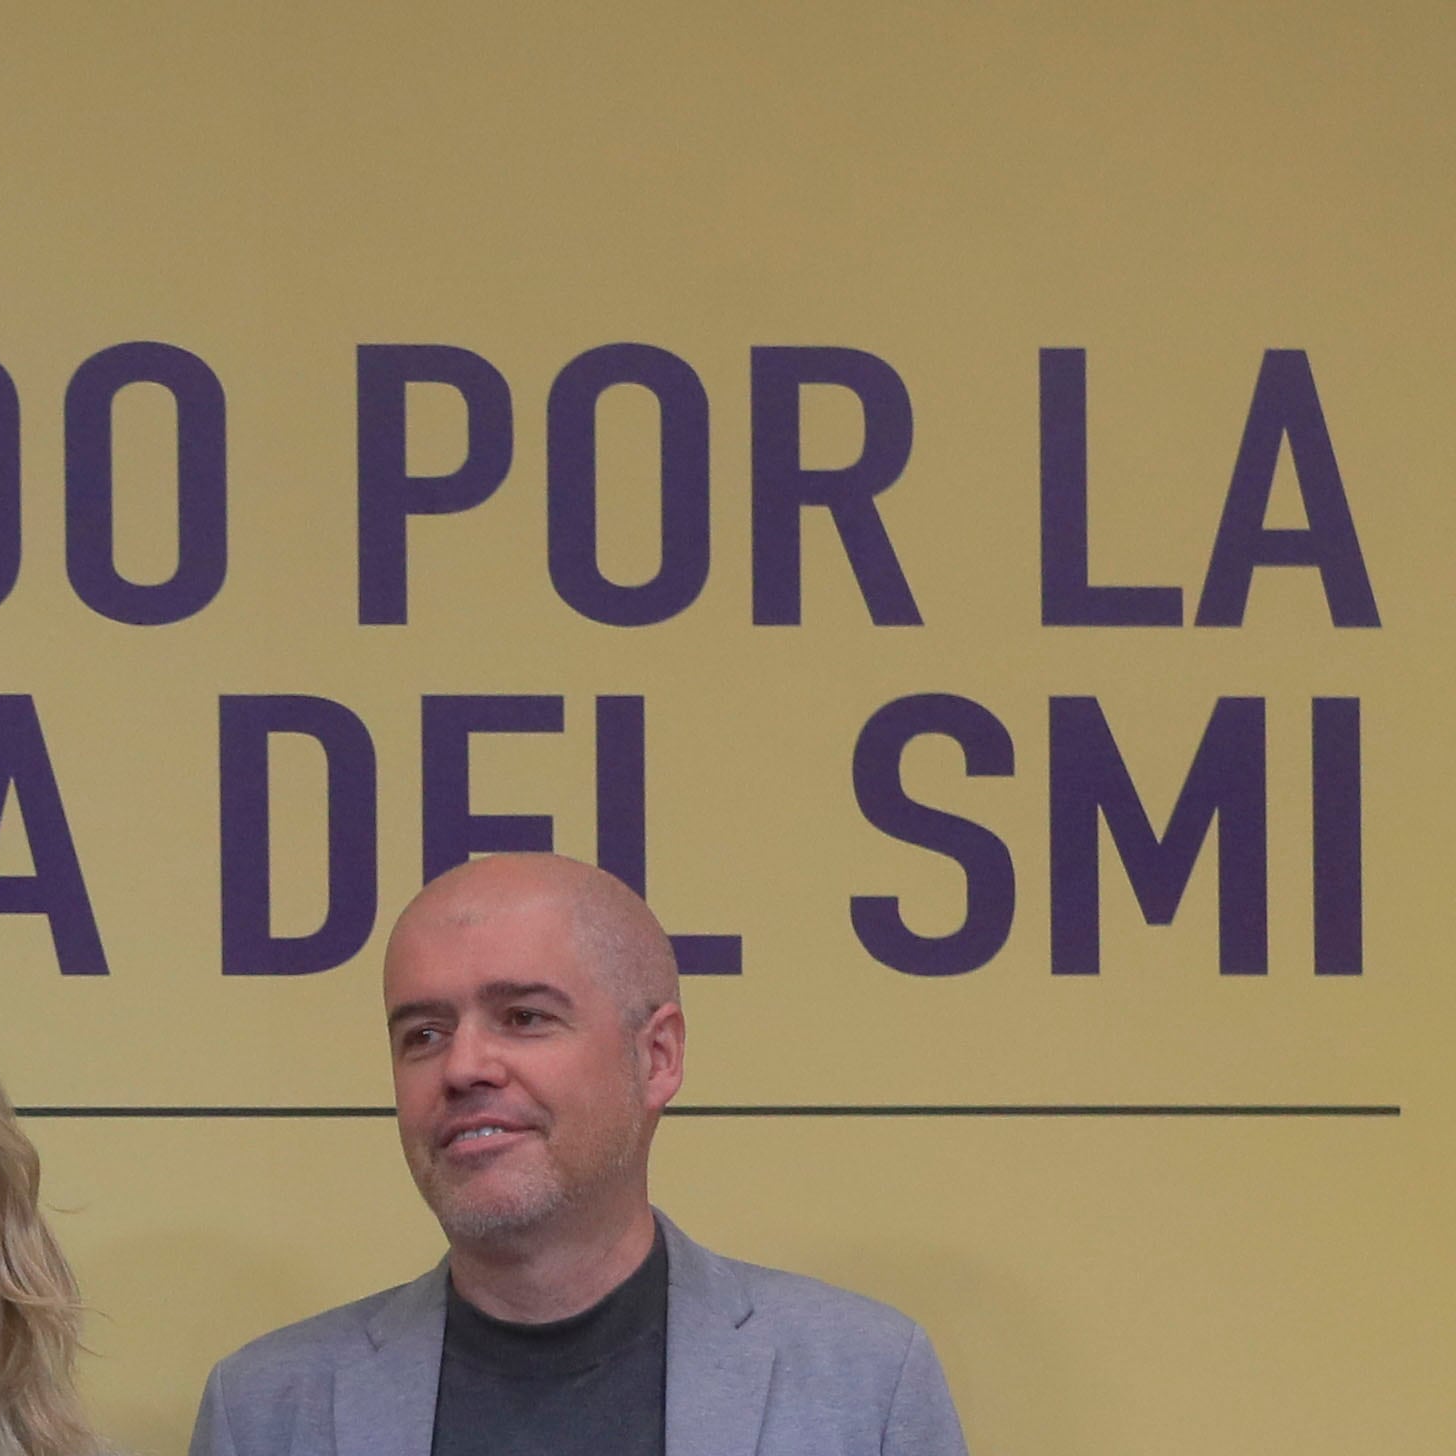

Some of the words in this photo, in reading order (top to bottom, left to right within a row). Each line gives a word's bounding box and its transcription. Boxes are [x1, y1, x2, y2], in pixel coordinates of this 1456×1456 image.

[357, 343, 923, 627] POR
[1039, 348, 1381, 627] LA
[218, 693, 743, 976] DEL
[850, 693, 1362, 976] SMI
